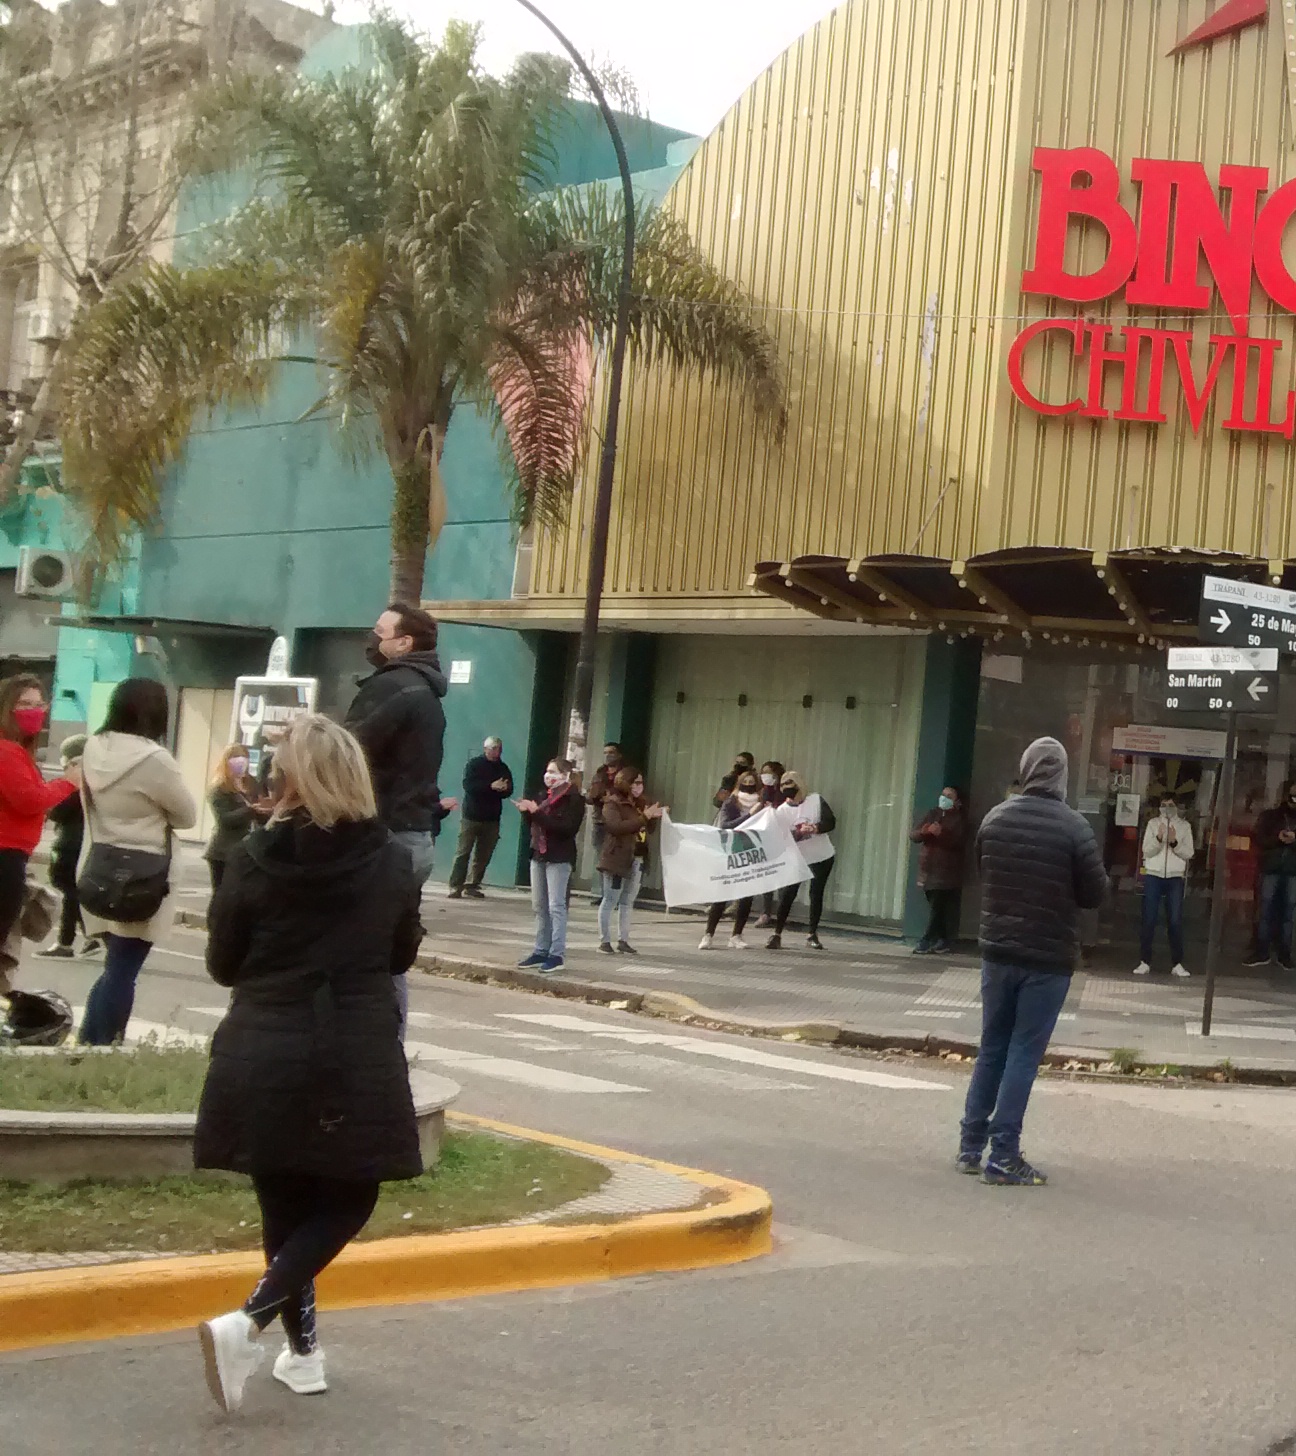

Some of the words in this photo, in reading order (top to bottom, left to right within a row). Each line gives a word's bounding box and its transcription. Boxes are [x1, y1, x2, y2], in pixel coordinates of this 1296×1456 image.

[1251, 613, 1265, 628] 25
[1267, 616, 1279, 631] de
[1248, 634, 1261, 646] 50
[1168, 673, 1185, 687] San
[1187, 673, 1222, 688] Martín
[1166, 697, 1179, 708] 00
[1209, 698, 1223, 709] 50
[727, 846, 768, 870] ALEARA
[710, 872, 741, 882] Sindicato
[751, 861, 786, 873] Trabajadores
[733, 875, 755, 884] Juegos
